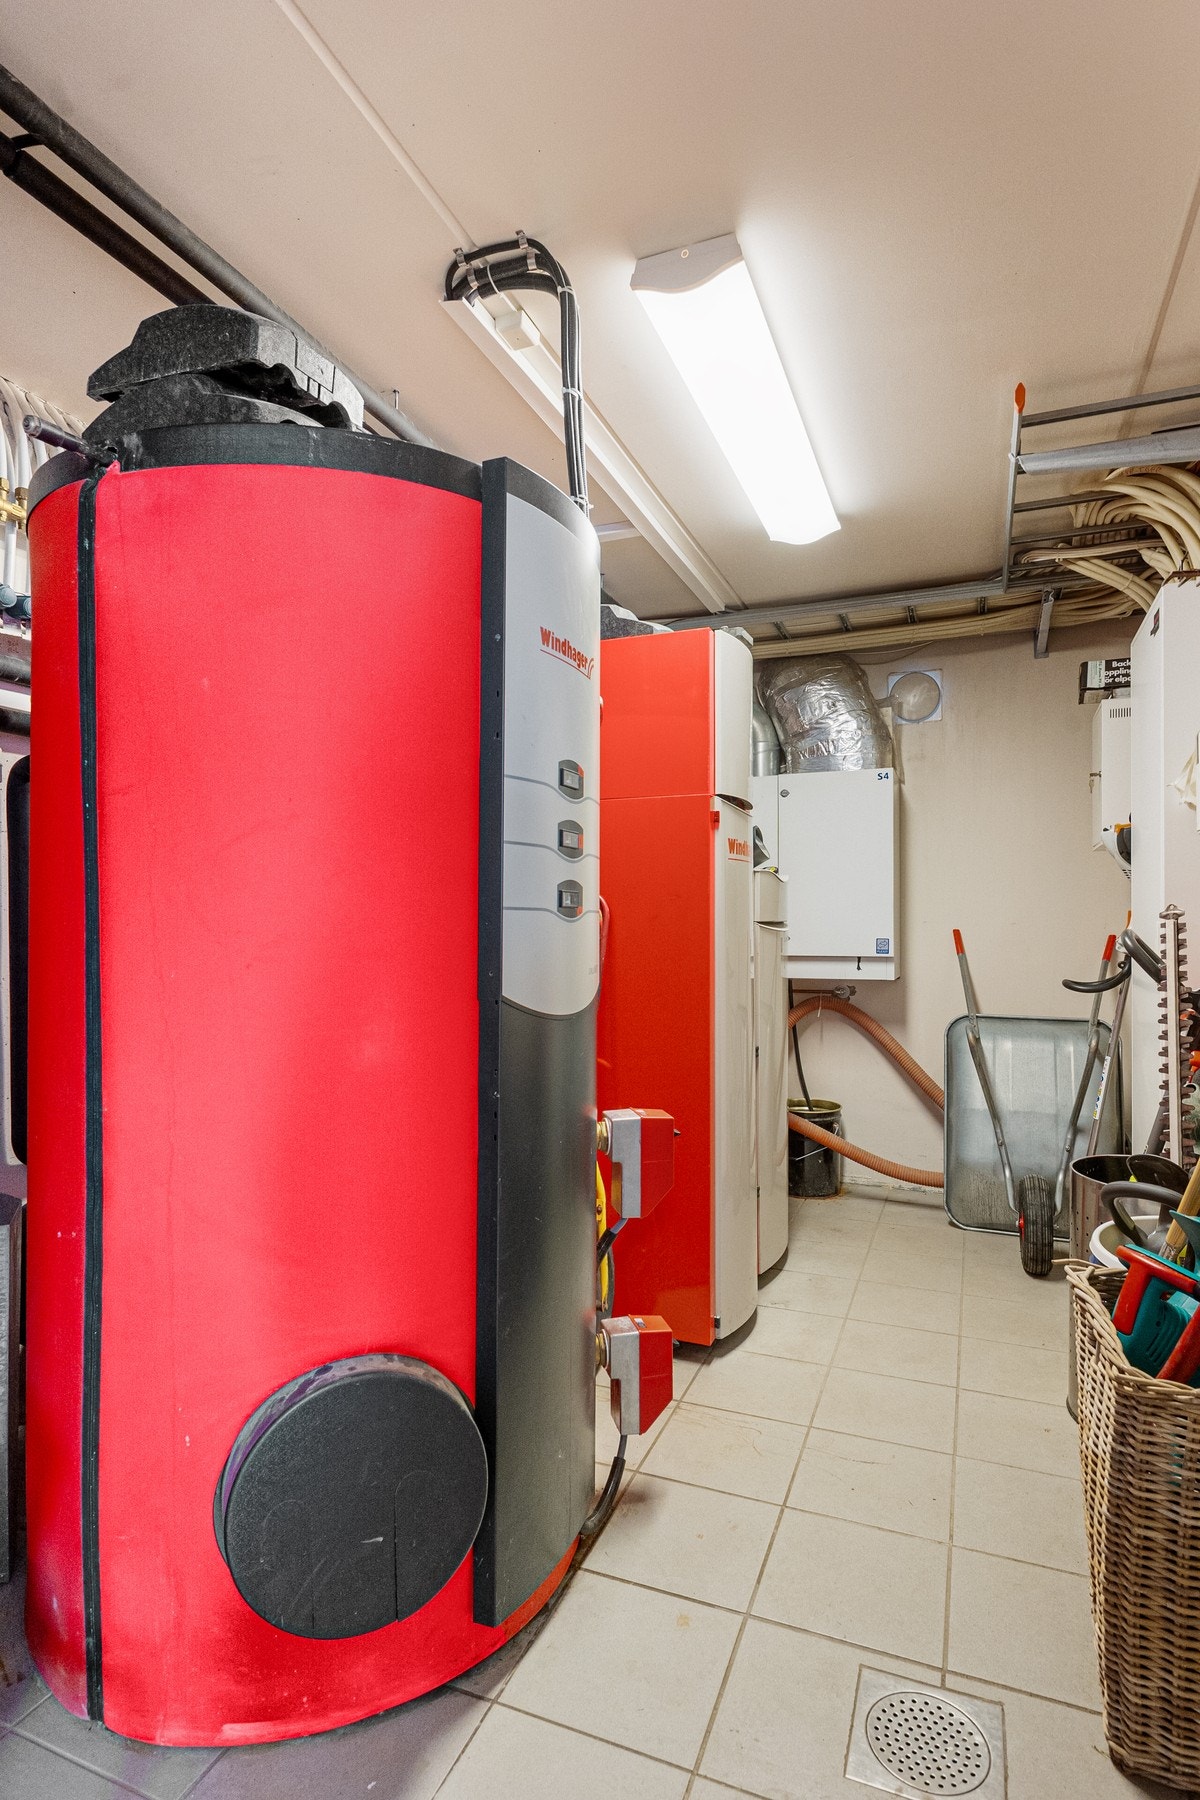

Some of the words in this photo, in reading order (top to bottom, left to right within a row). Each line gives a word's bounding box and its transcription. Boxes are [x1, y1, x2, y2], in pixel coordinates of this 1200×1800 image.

[540, 626, 589, 670] Windhager
[1104, 668, 1131, 676] opplin
[877, 772, 889, 781] S4
